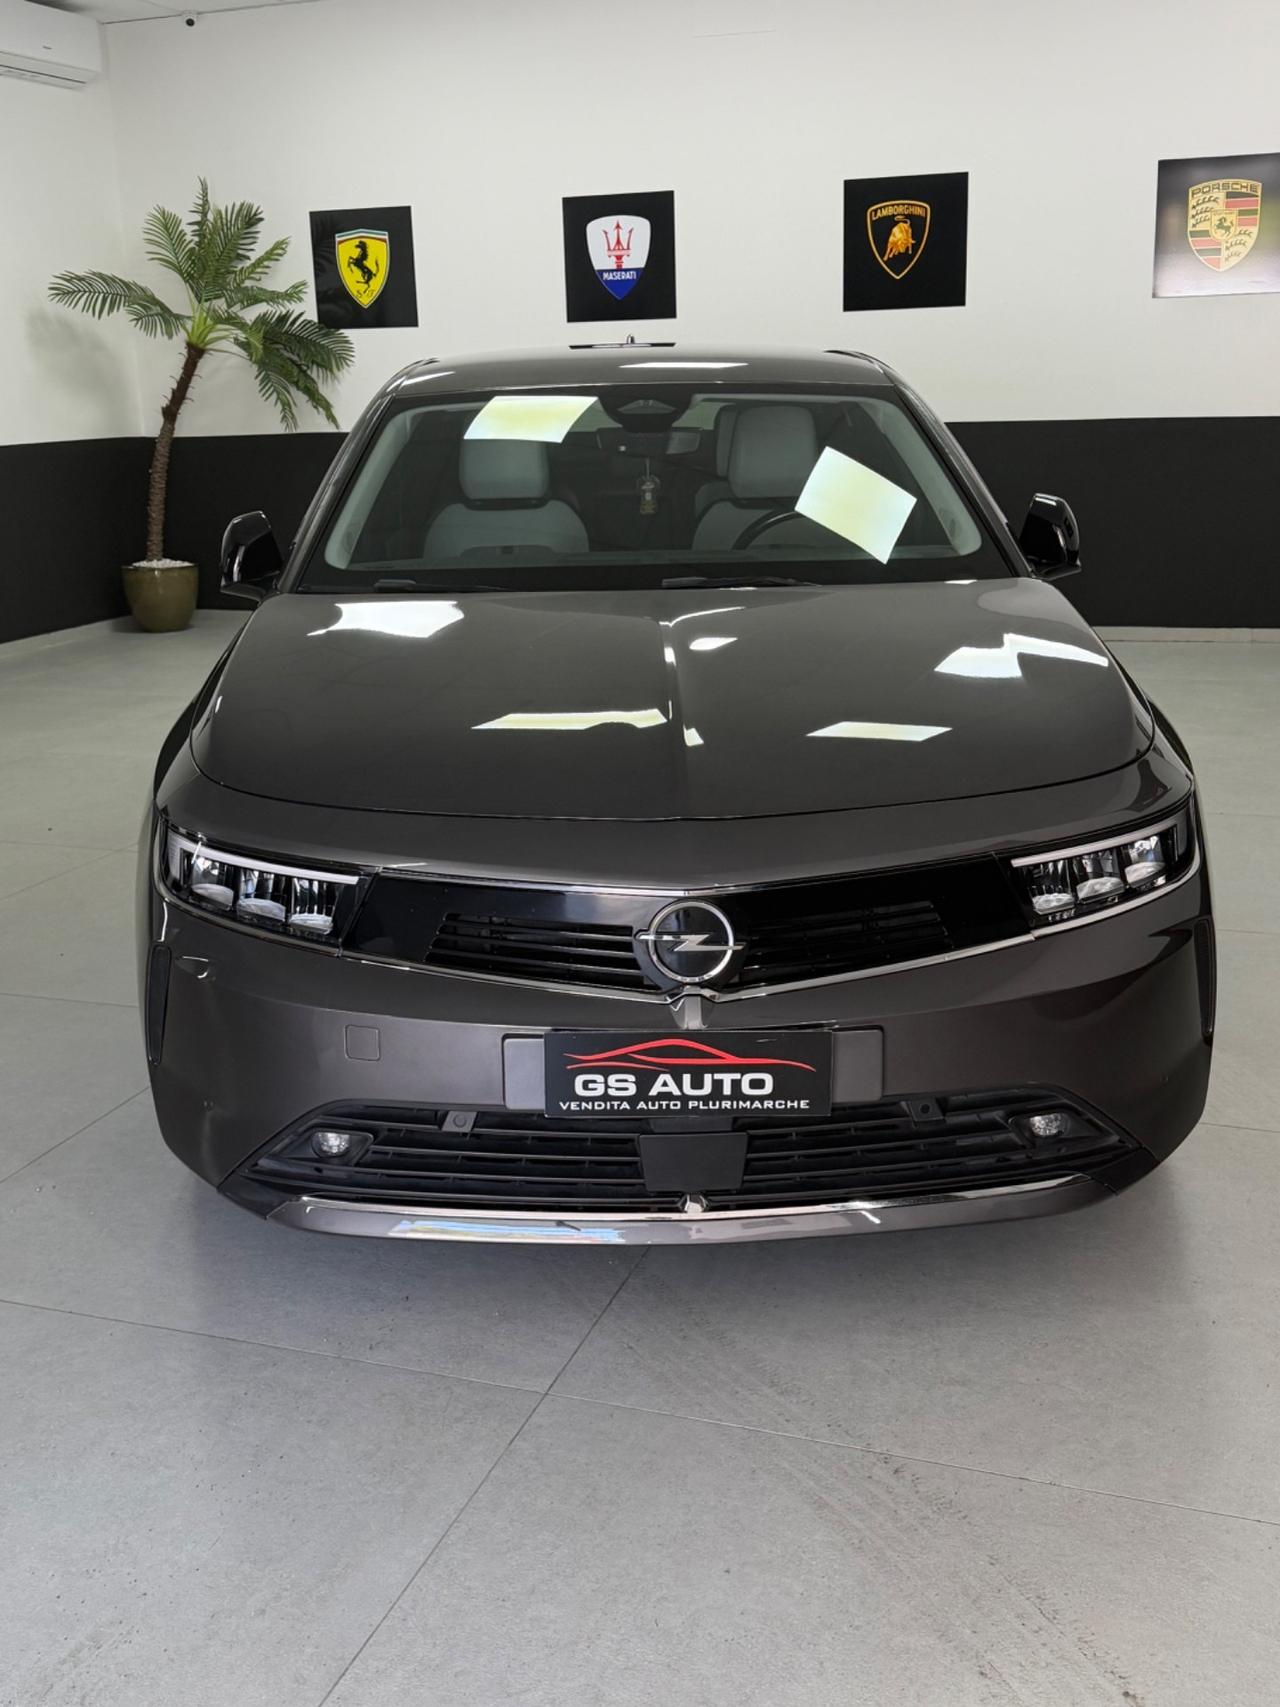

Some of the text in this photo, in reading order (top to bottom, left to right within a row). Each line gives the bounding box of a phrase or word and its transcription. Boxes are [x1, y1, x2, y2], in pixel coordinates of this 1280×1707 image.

[1191, 182, 1260, 198] PORSCHE
[872, 205, 926, 220] LAMBORGHINI
[602, 271, 636, 281] MASERATI
[574, 1072, 774, 1097] GS AUTO
[559, 1099, 810, 1110] VENDITA AUTO PLURIMARCHE
